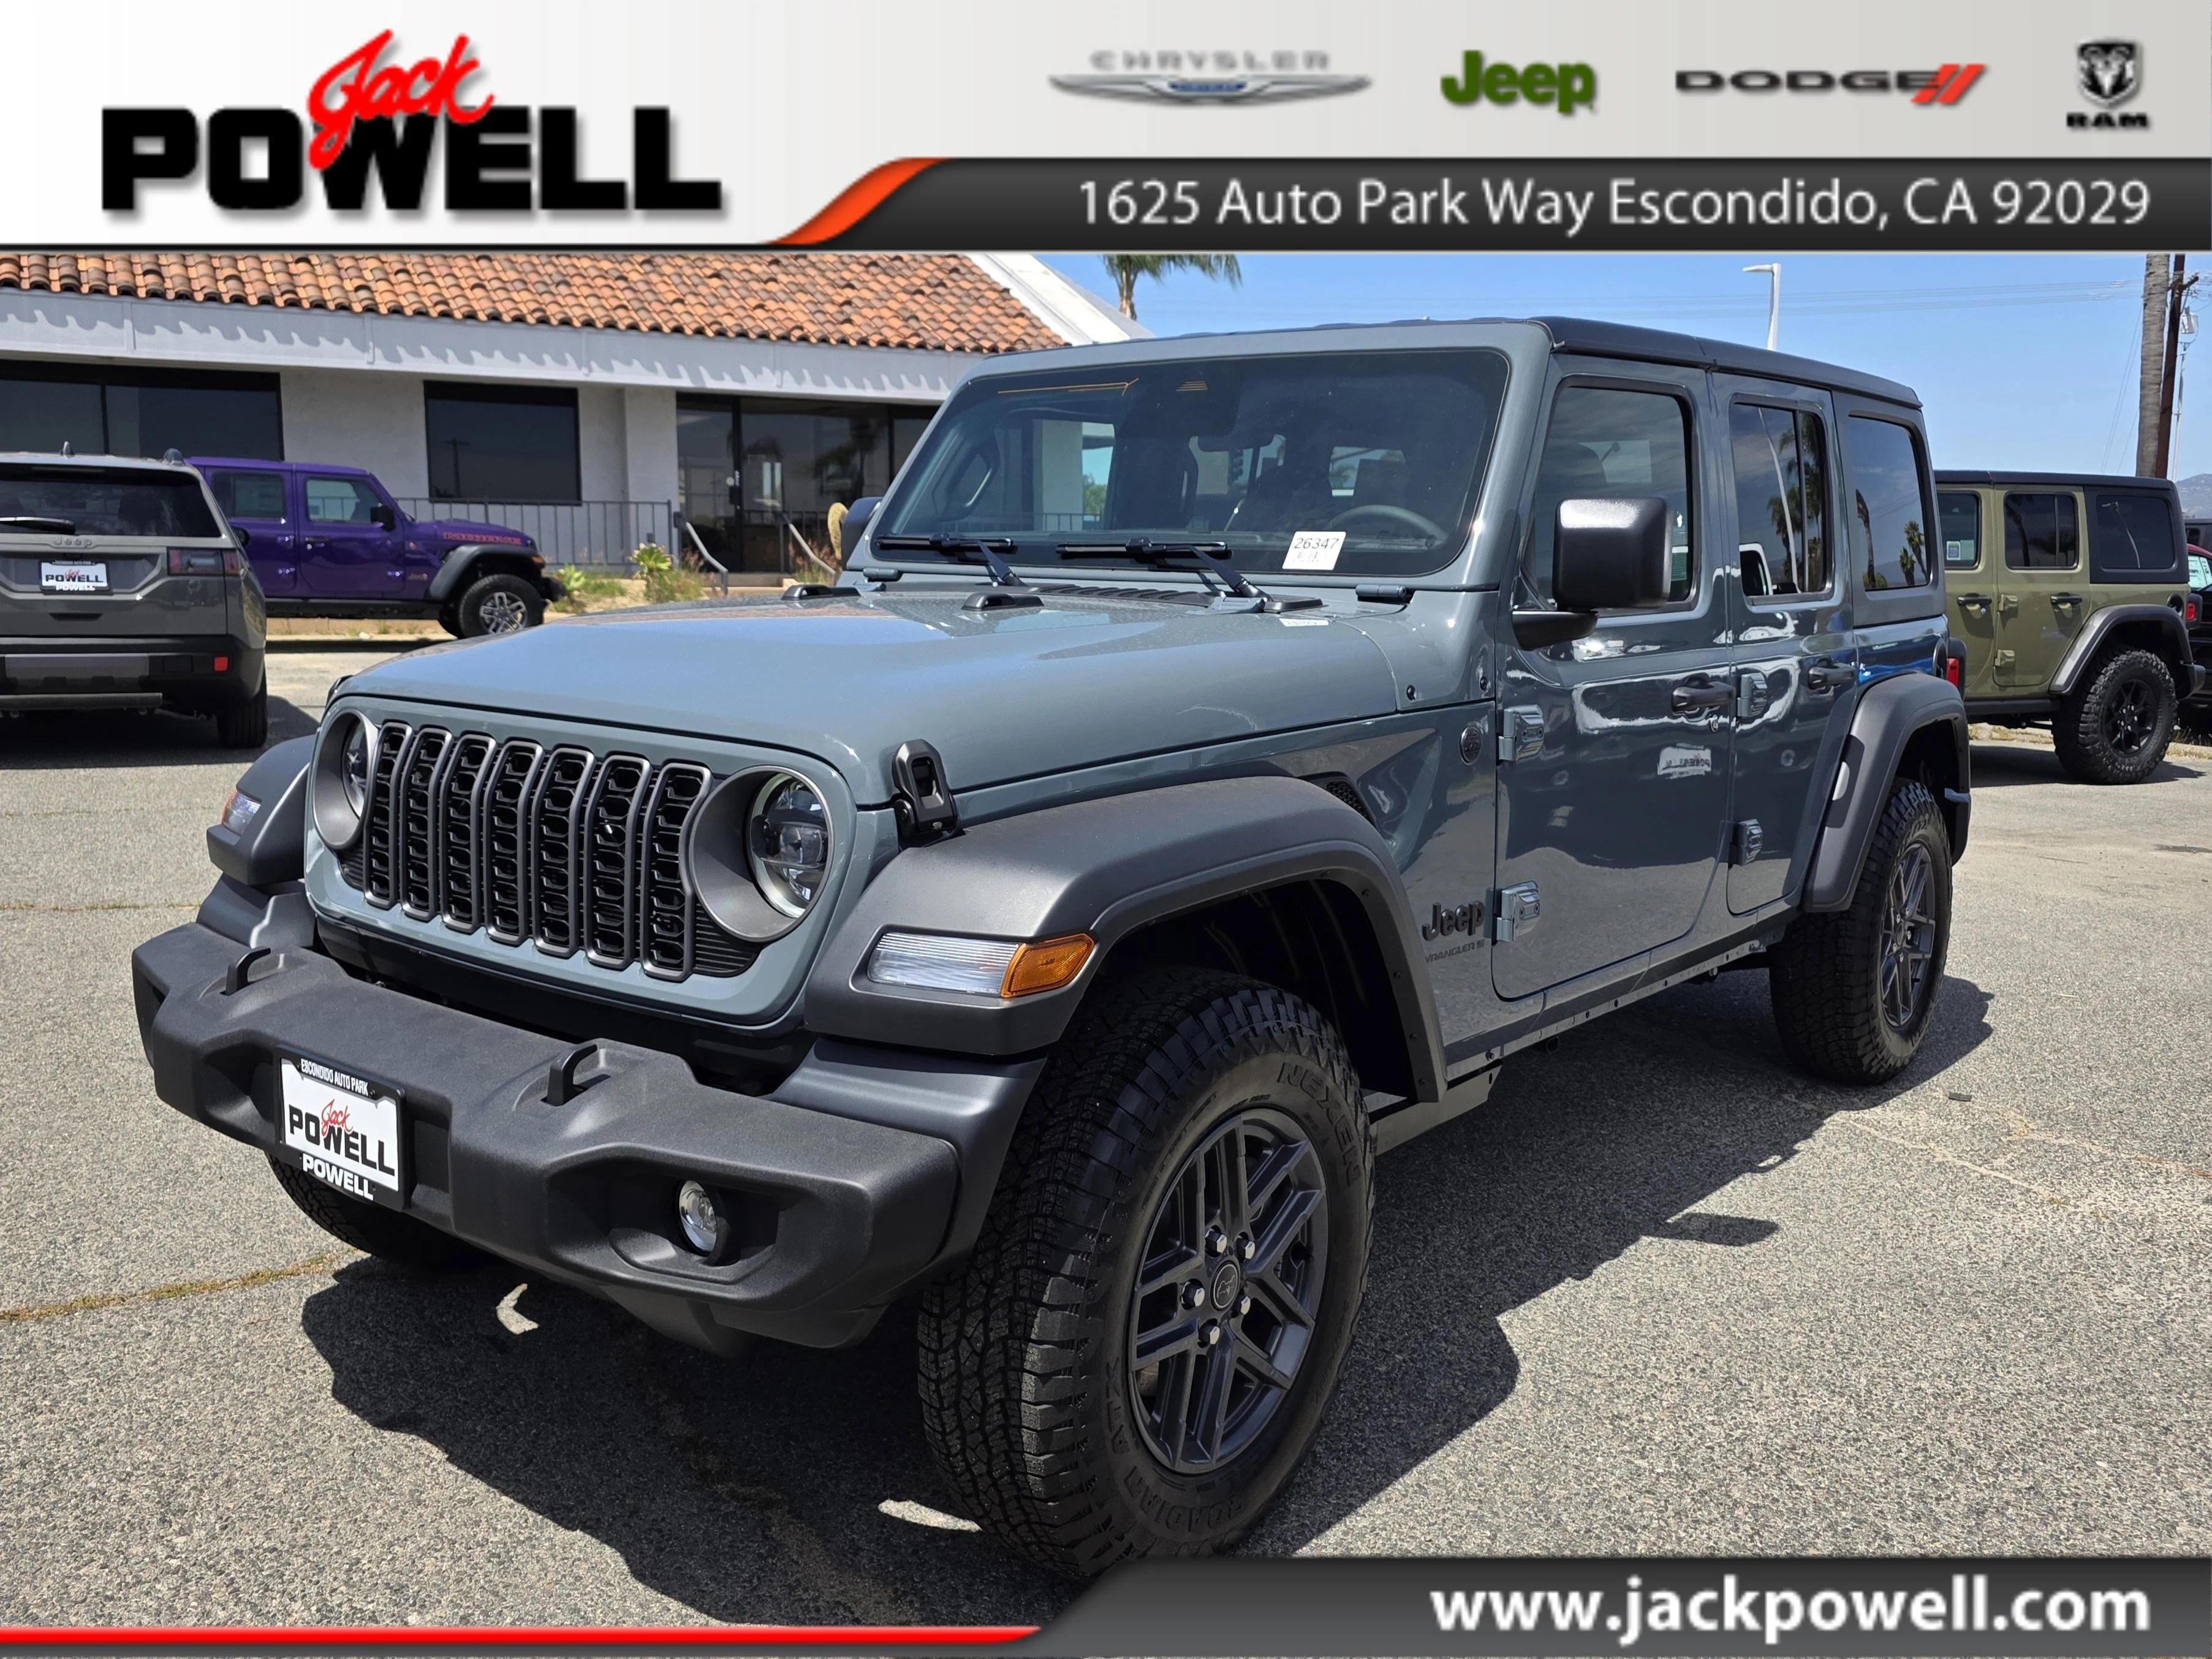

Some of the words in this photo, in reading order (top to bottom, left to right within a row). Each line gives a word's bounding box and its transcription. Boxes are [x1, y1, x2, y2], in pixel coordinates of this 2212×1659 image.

[53, 536, 93, 548] Jeep
[1293, 537, 1339, 550] 26347
[45, 574, 104, 583] POWELL
[1422, 900, 1485, 942] Jeep
[300, 1058, 334, 1084] ESCONDIDO
[334, 1071, 351, 1090] AUTO
[350, 1077, 369, 1096] PARK
[321, 1098, 354, 1136] Jack
[1276, 1061, 1362, 1186] NEXEN
[289, 1104, 396, 1177] POWELL
[302, 1153, 374, 1201] POWELL
